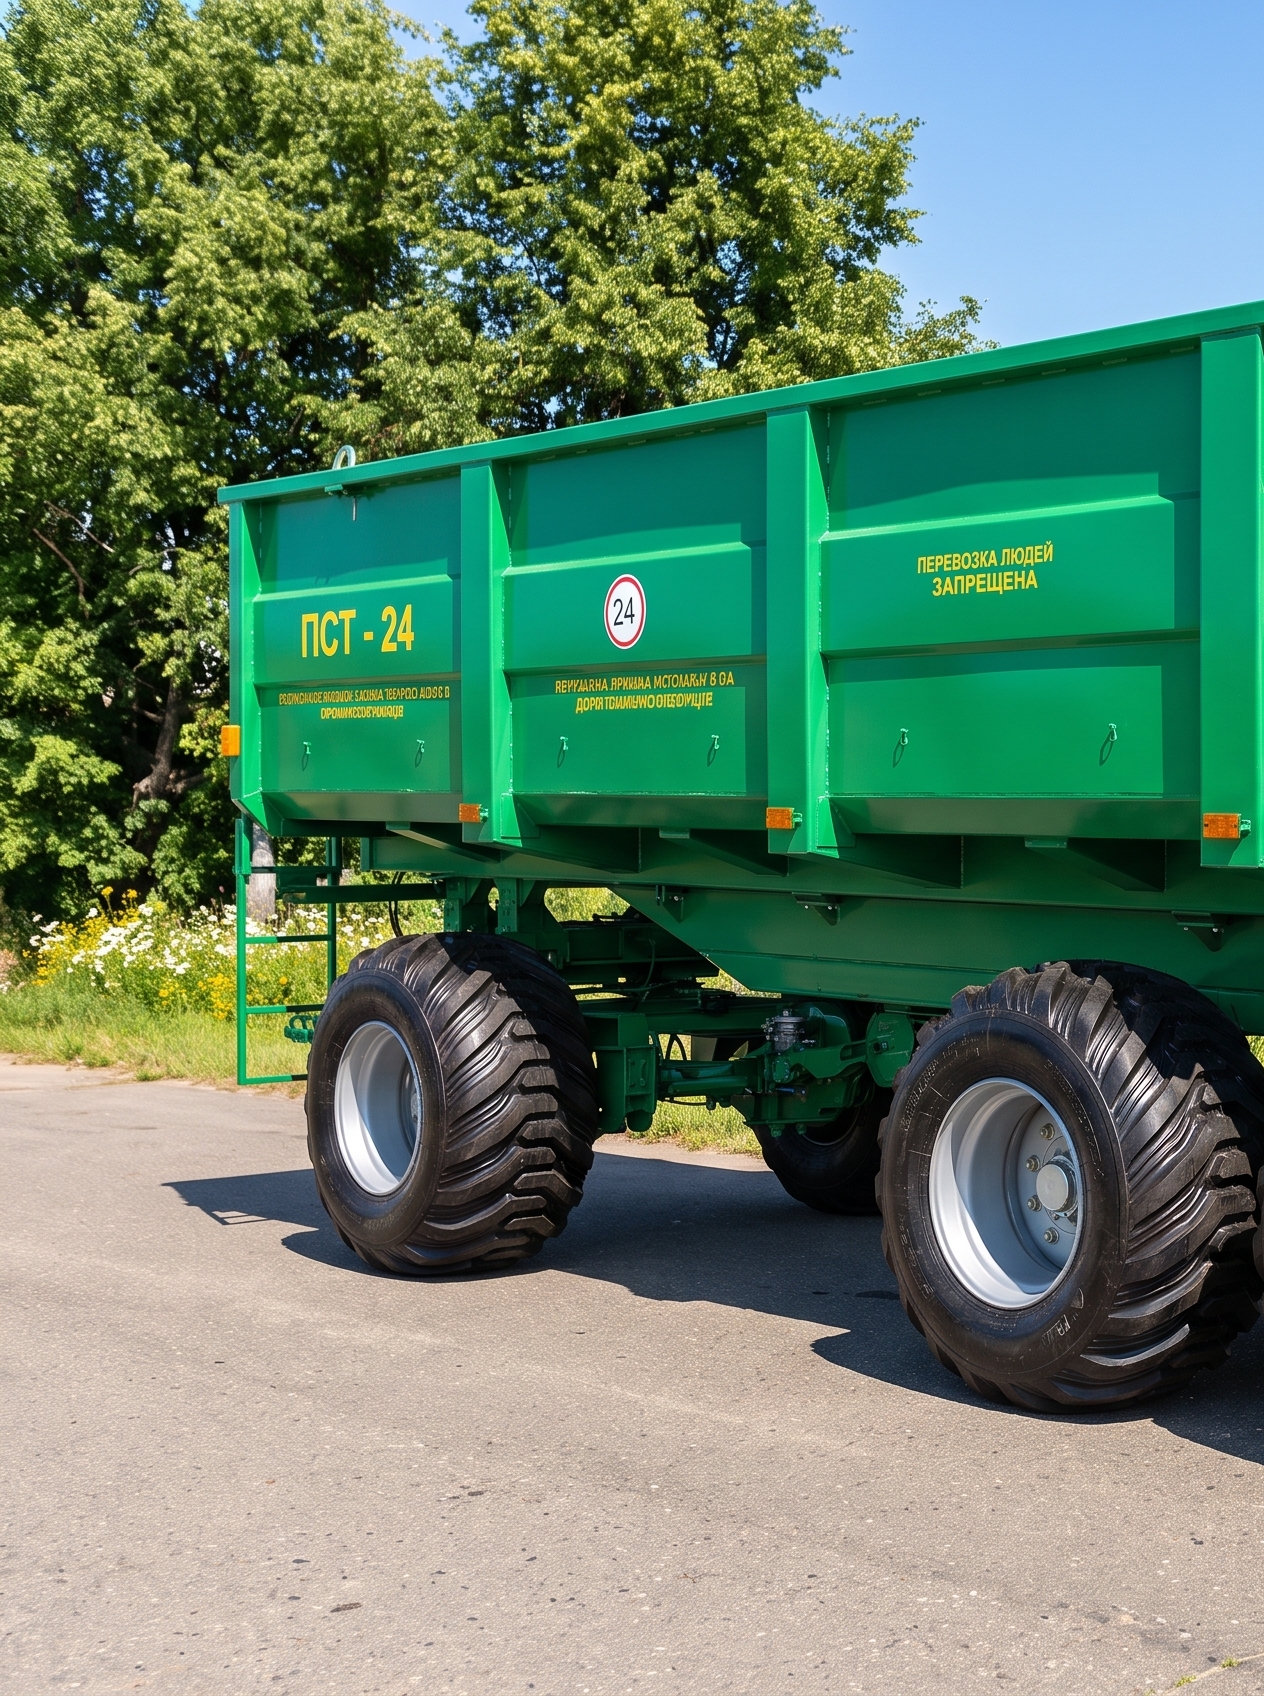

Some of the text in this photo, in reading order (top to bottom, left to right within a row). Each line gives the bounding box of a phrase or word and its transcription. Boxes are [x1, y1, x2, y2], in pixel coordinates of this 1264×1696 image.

[917, 540, 1053, 574] ПЕРЕВОЗКА ЛЮДЕЙ
[932, 569, 1038, 597] ЗАПРЕЩЕНА
[613, 597, 635, 626] 24
[301, 609, 357, 658] ПСТ
[381, 604, 415, 653] 24
